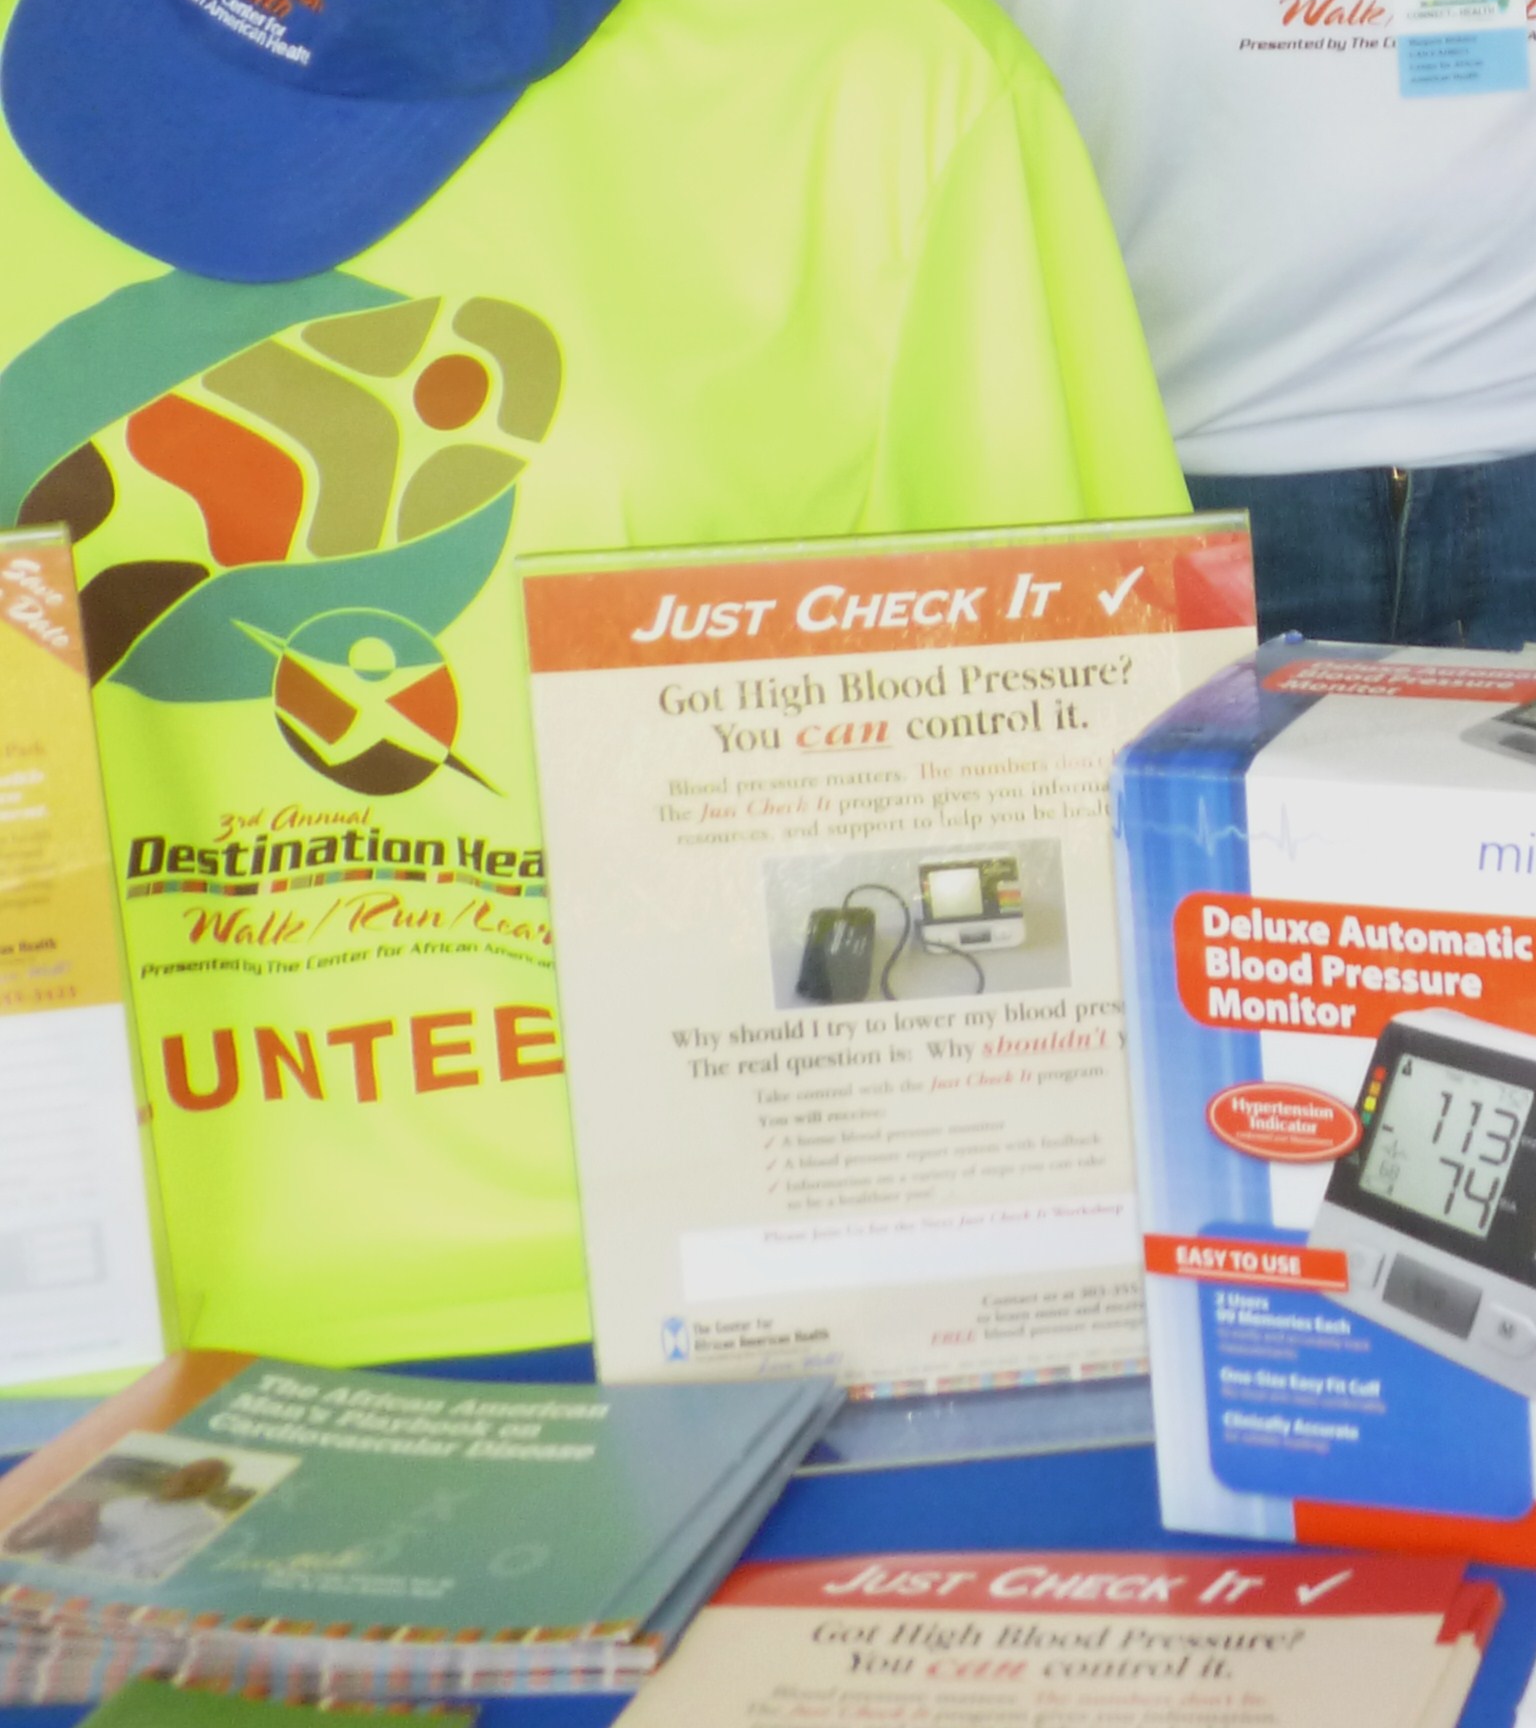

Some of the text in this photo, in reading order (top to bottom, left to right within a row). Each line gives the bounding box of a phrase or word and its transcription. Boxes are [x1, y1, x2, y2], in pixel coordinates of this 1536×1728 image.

[1239, 37, 1323, 52] Presented
[1326, 38, 1347, 52] by
[1351, 36, 1379, 50] The
[631, 573, 1062, 644] JUST CHECK IT
[658, 654, 1133, 719] Got High Blood Pressure?
[711, 699, 1090, 755] You can control it.
[932, 785, 982, 807] gives
[988, 785, 1024, 804] you
[213, 803, 372, 842] 3rd Annual
[914, 814, 934, 831] to
[991, 808, 1027, 826] you
[126, 827, 445, 881] Destination
[1202, 904, 1534, 962] Deluxe Automatic
[140, 939, 479, 980] Presented by The Center for African
[1205, 946, 1483, 1000] Blood Pressure
[671, 1000, 1067, 1051] Why should try to lower my blood
[1208, 986, 1356, 1029] Monitor
[687, 1027, 1108, 1081] The real question Why shouldn't
[1231, 1095, 1334, 1121] Hypertension
[1250, 1115, 1318, 1134] Indicator
[1175, 1245, 1302, 1276] EASY TO USE
[1227, 1293, 1269, 1311] Users
[1238, 1310, 1350, 1335] Memories Each
[259, 1373, 612, 1421] The African American
[464, 1440, 596, 1461] Disease
[498, 1423, 543, 1439] on
[824, 1566, 1265, 1605] JUST CHECK IT
[811, 1620, 1304, 1656] Got High Blood Pressure?
[846, 1651, 1190, 1680] You control
